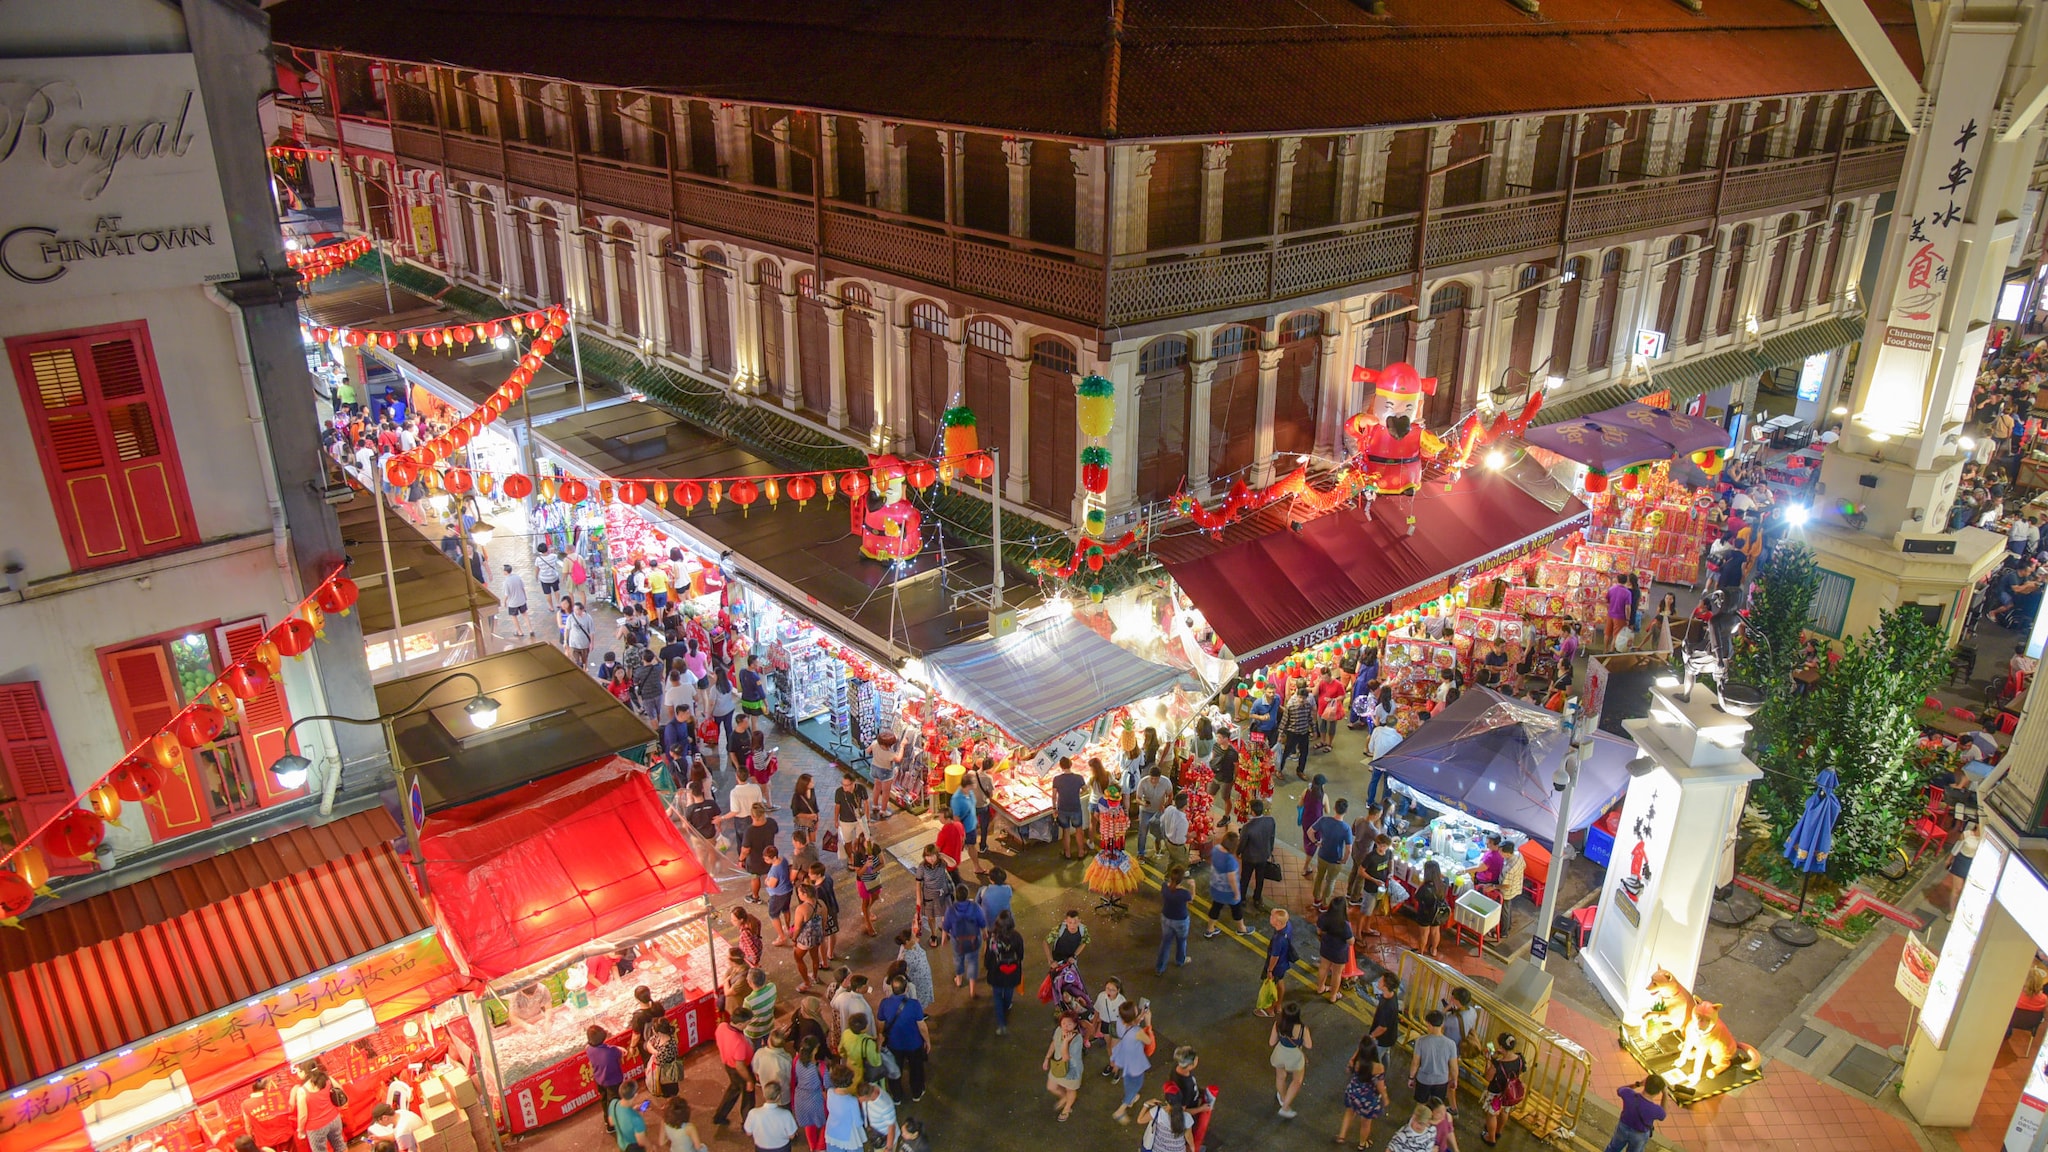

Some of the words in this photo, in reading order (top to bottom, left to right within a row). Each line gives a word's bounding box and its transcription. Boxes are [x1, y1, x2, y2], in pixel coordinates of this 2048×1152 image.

[0, 80, 196, 201] Royal
[96, 215, 123, 234] AT
[1, 225, 216, 285] CHINATOWN
[1886, 336, 1907, 346] Food
[1907, 339, 1931, 350] Street
[1889, 328, 1933, 342] Chinatown
[1477, 549, 1520, 573] Wholesale
[1521, 543, 1529, 555] &
[1531, 530, 1556, 549] Retail
[1304, 621, 1340, 649] LESLIE
[147, 952, 418, 1076] 全美香水与化妆品
[560, 1089, 598, 1116] NATURAL
[622, 1064, 645, 1082] PERSI
